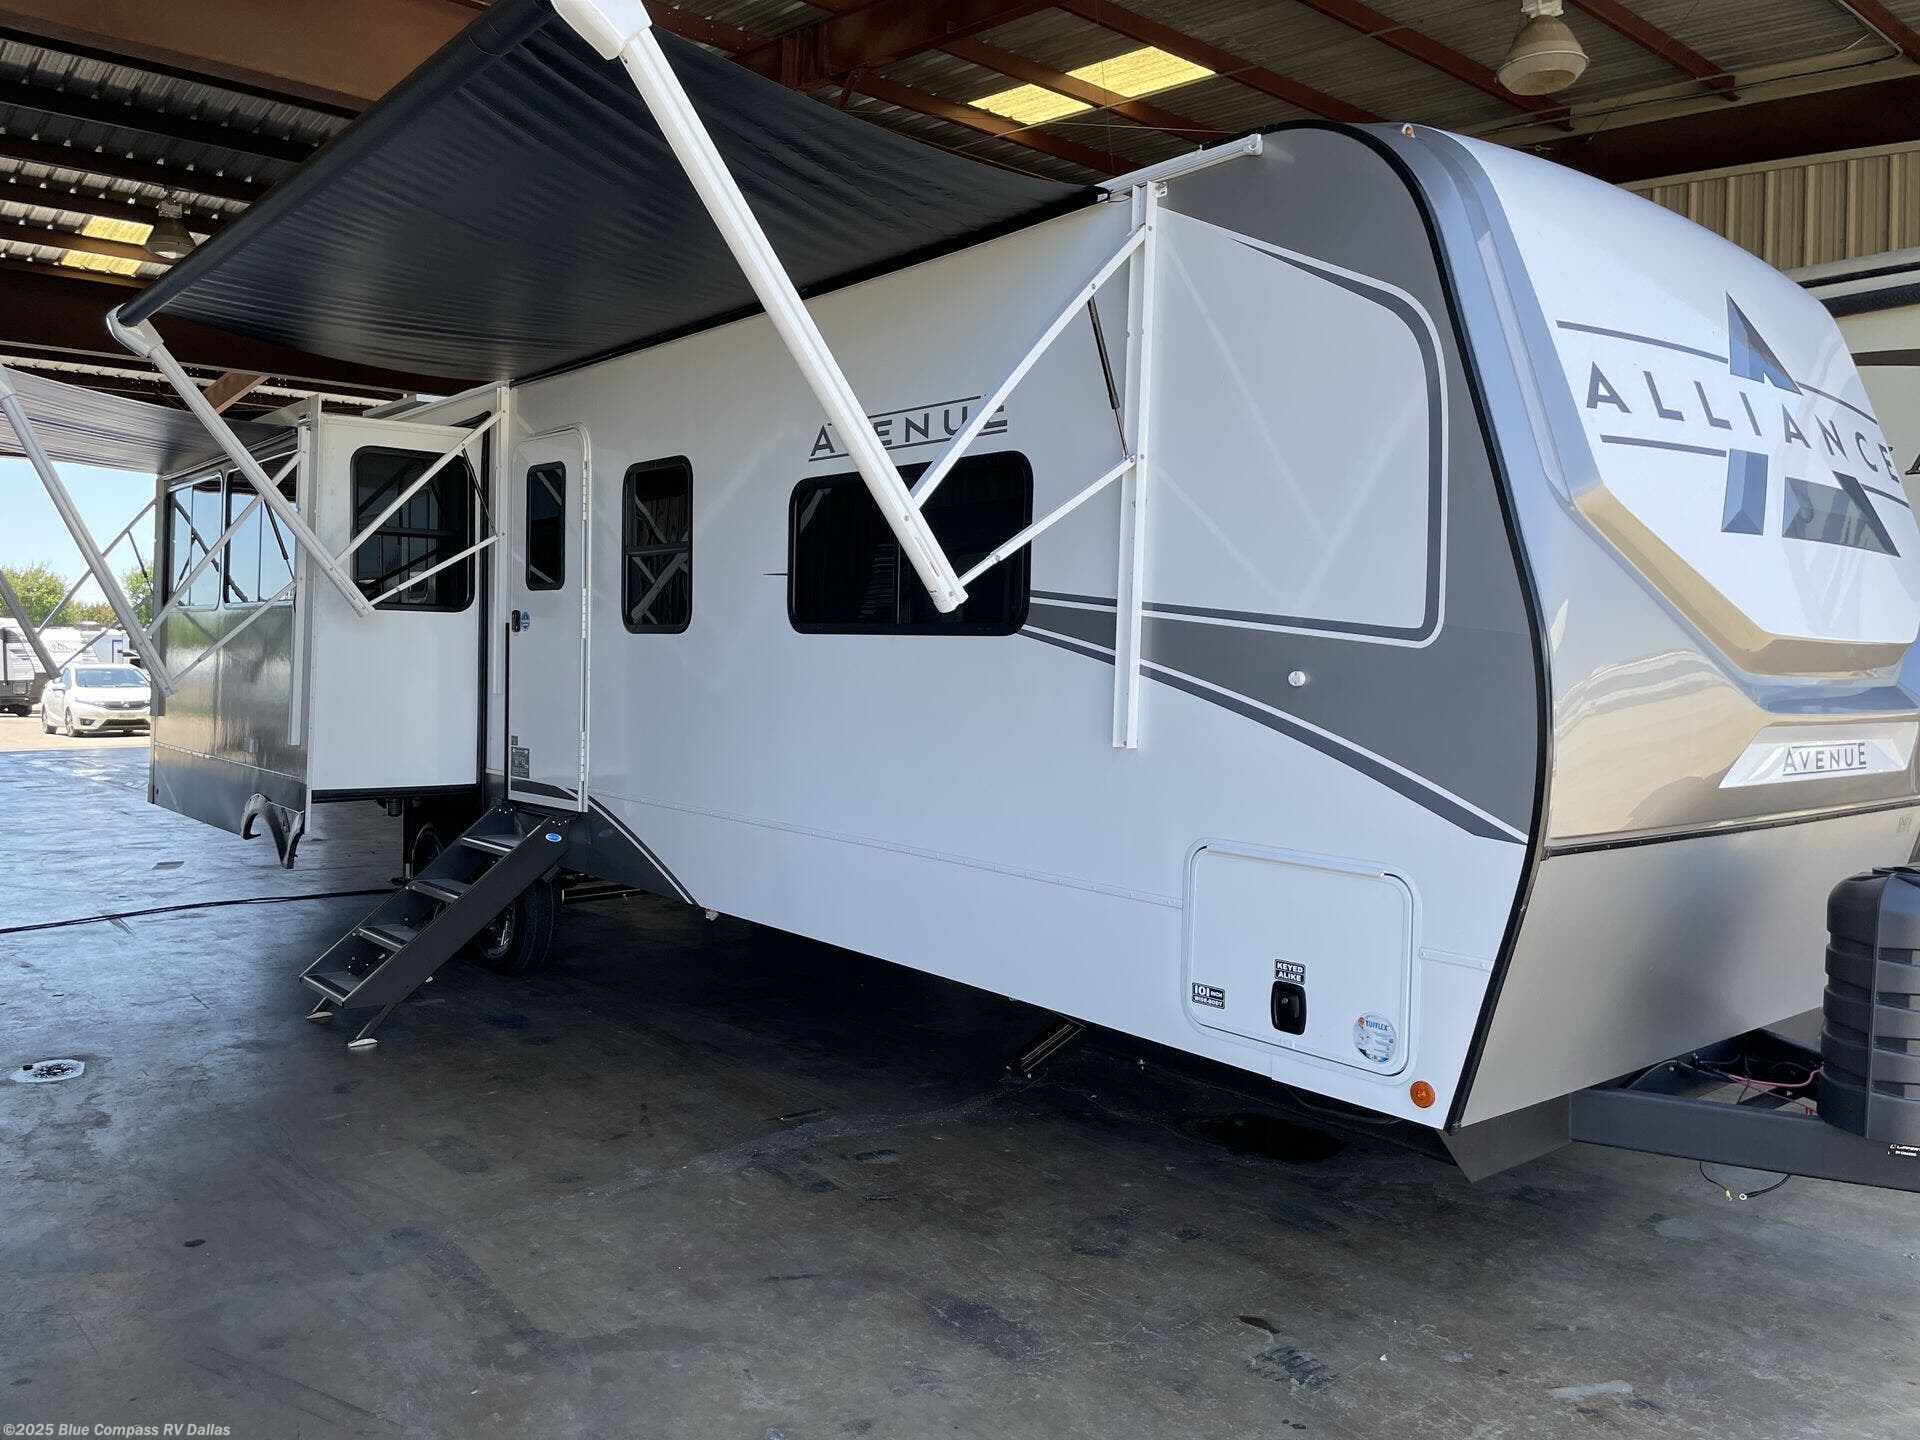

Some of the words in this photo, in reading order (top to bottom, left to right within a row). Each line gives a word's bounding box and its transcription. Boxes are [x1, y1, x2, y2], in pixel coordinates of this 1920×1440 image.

[812, 399, 1008, 456] AENU
[1586, 361, 1900, 484] ALLIANCE
[1783, 742, 1867, 772] AVENUE
[1277, 961, 1303, 973] KEYED
[1278, 971, 1302, 982] ALIKE
[1194, 984, 1210, 997] 101
[1366, 1020, 1388, 1032] TUFFLEX
